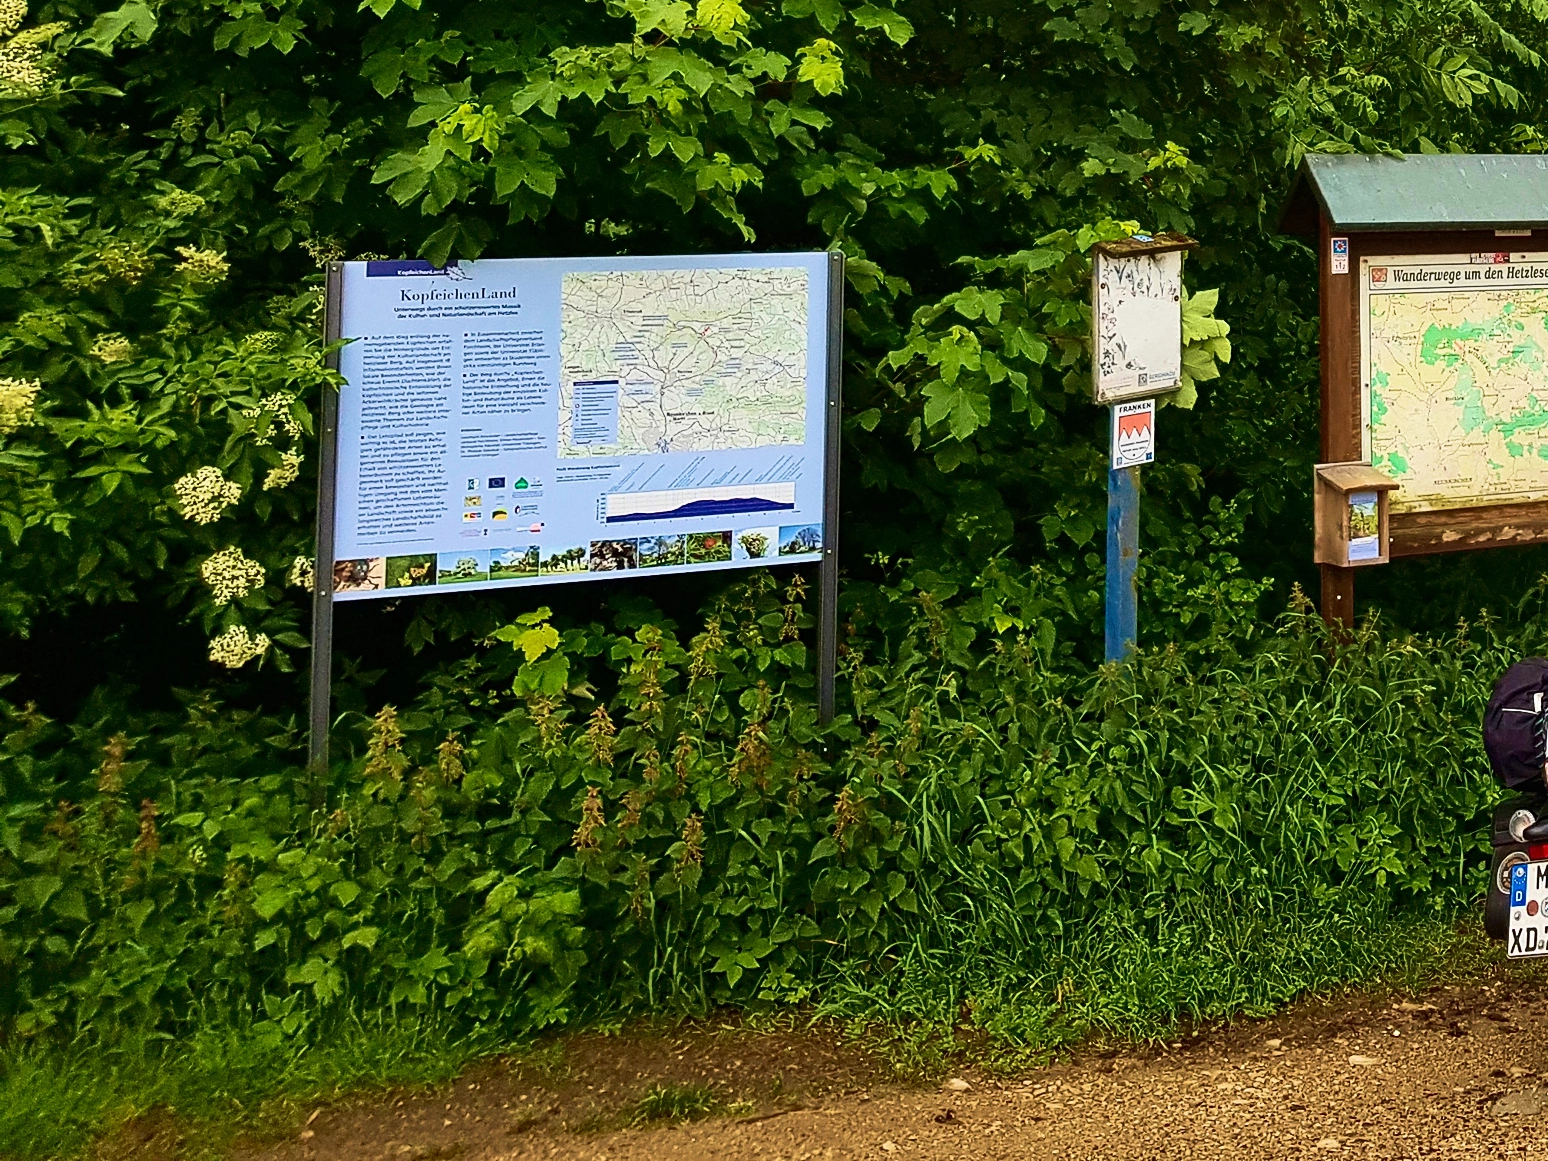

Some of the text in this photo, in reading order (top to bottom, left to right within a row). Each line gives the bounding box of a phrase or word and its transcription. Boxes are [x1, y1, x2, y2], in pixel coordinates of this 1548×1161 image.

[1393, 269, 1460, 284] Wanderwege
[1465, 269, 1481, 280] um
[1485, 267, 1503, 279] den
[400, 287, 516, 304] KopfeichenLand
[1119, 402, 1151, 413] FRANKEN
[1515, 891, 1523, 901] D
[1510, 927, 1537, 953] XD
